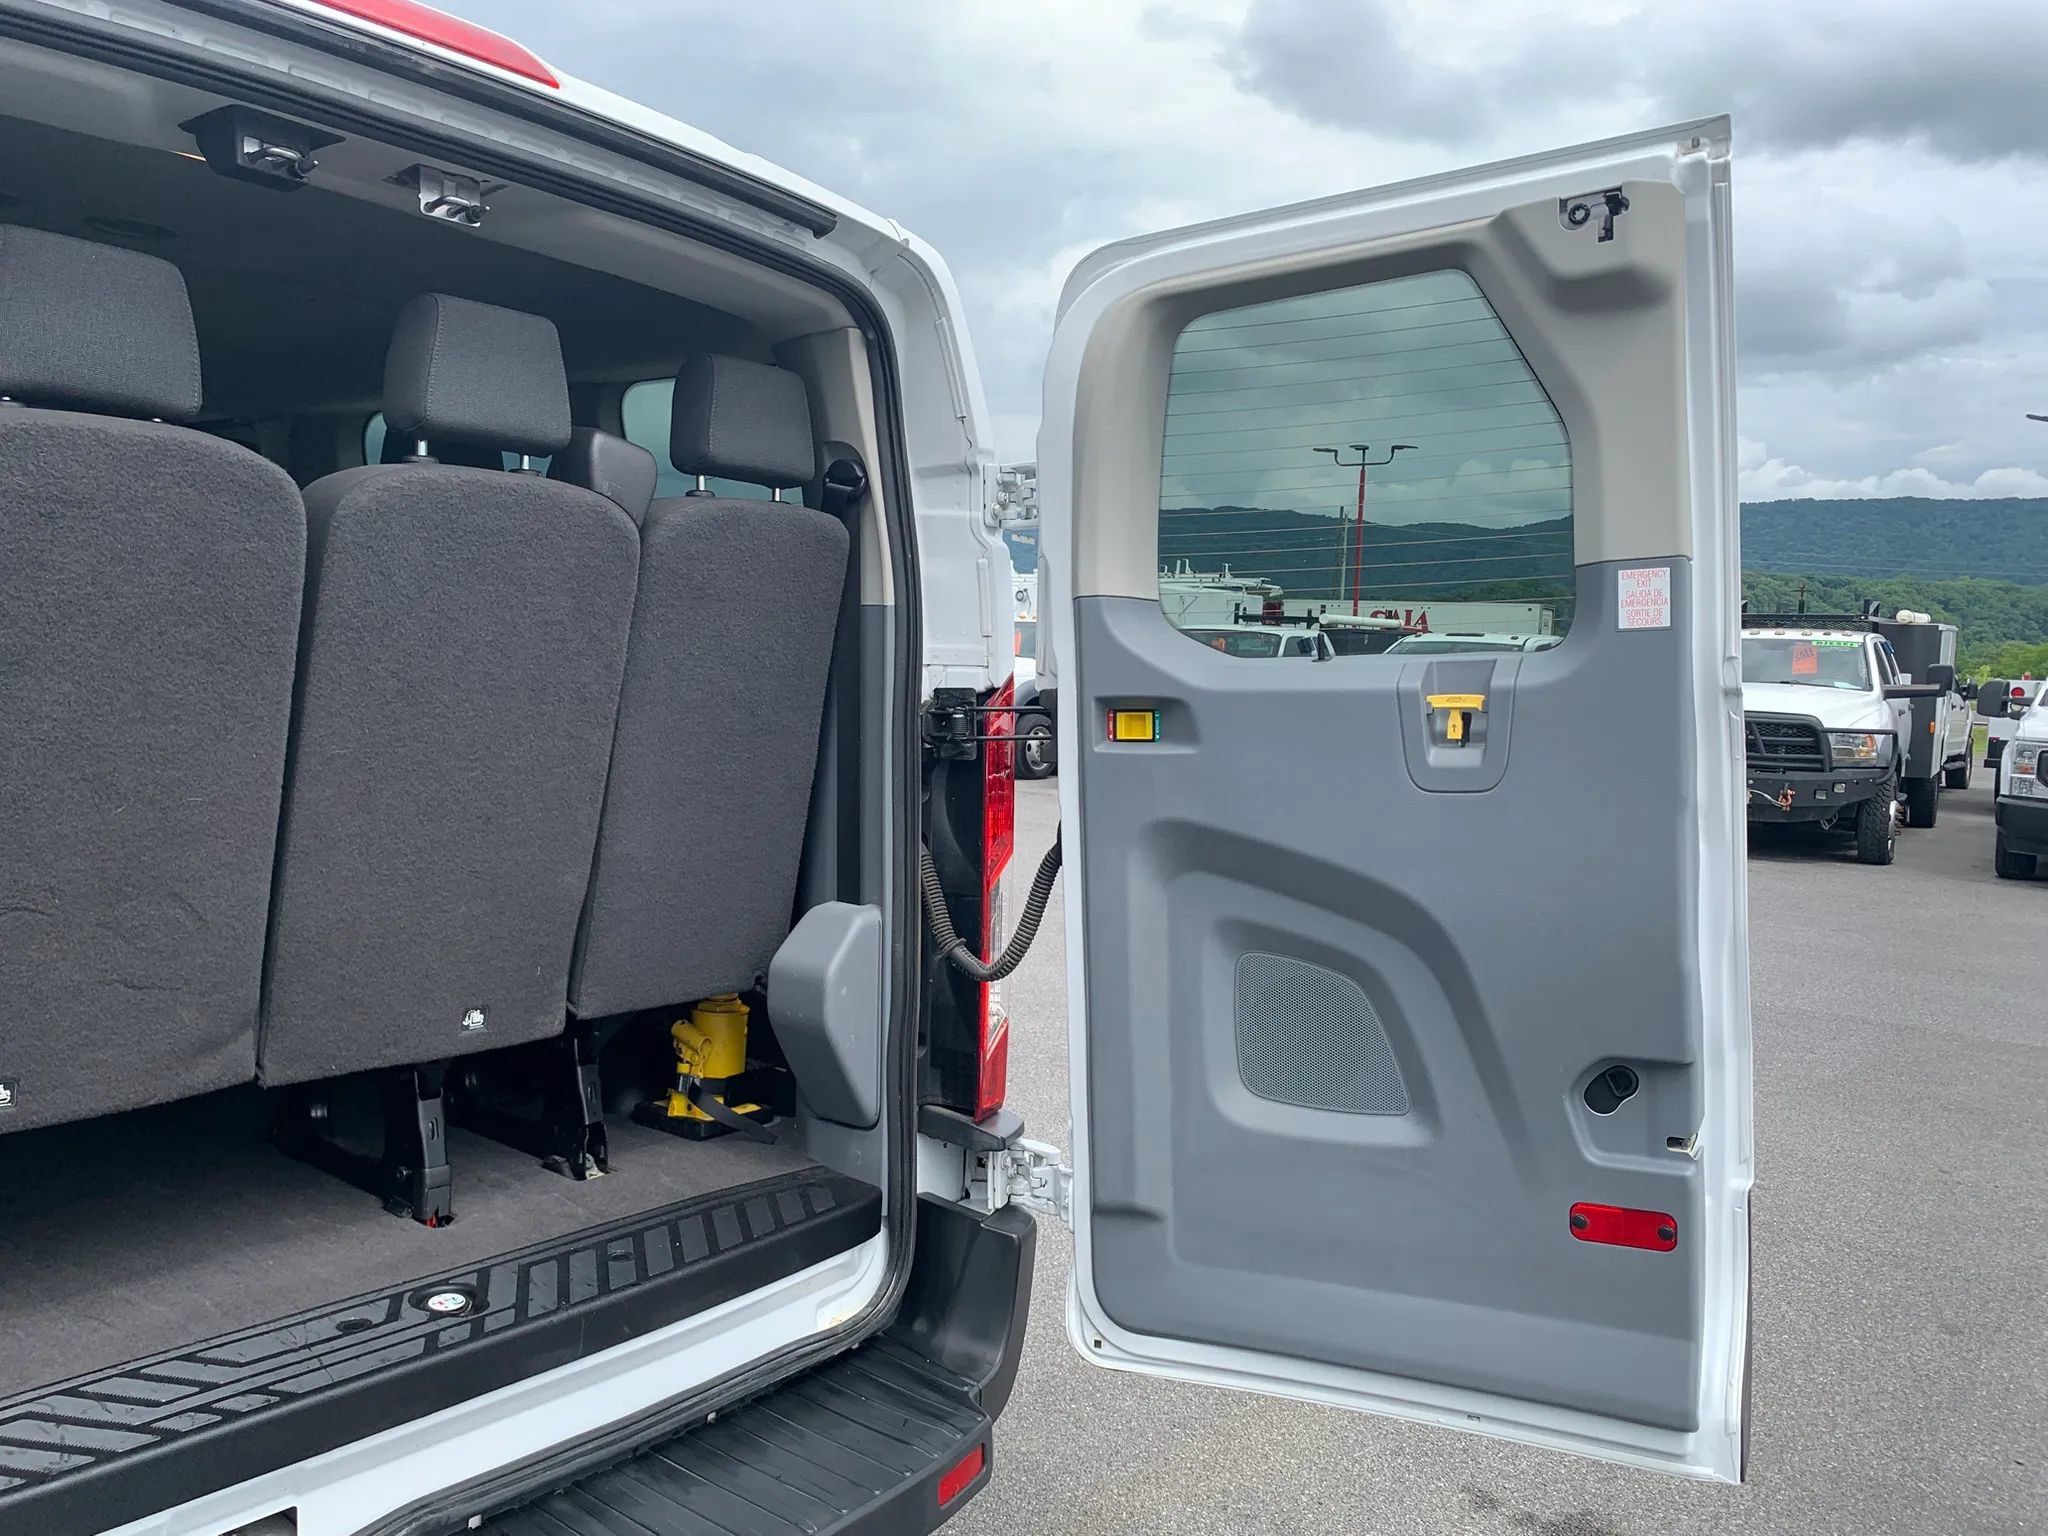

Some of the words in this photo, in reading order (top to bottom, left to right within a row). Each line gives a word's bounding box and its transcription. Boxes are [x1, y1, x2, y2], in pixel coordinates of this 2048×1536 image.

[1621, 569, 1667, 580] EMERGENCY
[1637, 580, 1651, 588] EXIT
[1625, 589, 1652, 598] SALIDA
[1653, 588, 1663, 597] DE
[1621, 597, 1668, 608] EMERGENCIA
[1626, 609, 1651, 618] SORTIE
[1653, 608, 1663, 616] DE
[1627, 617, 1663, 626] SECOURS
